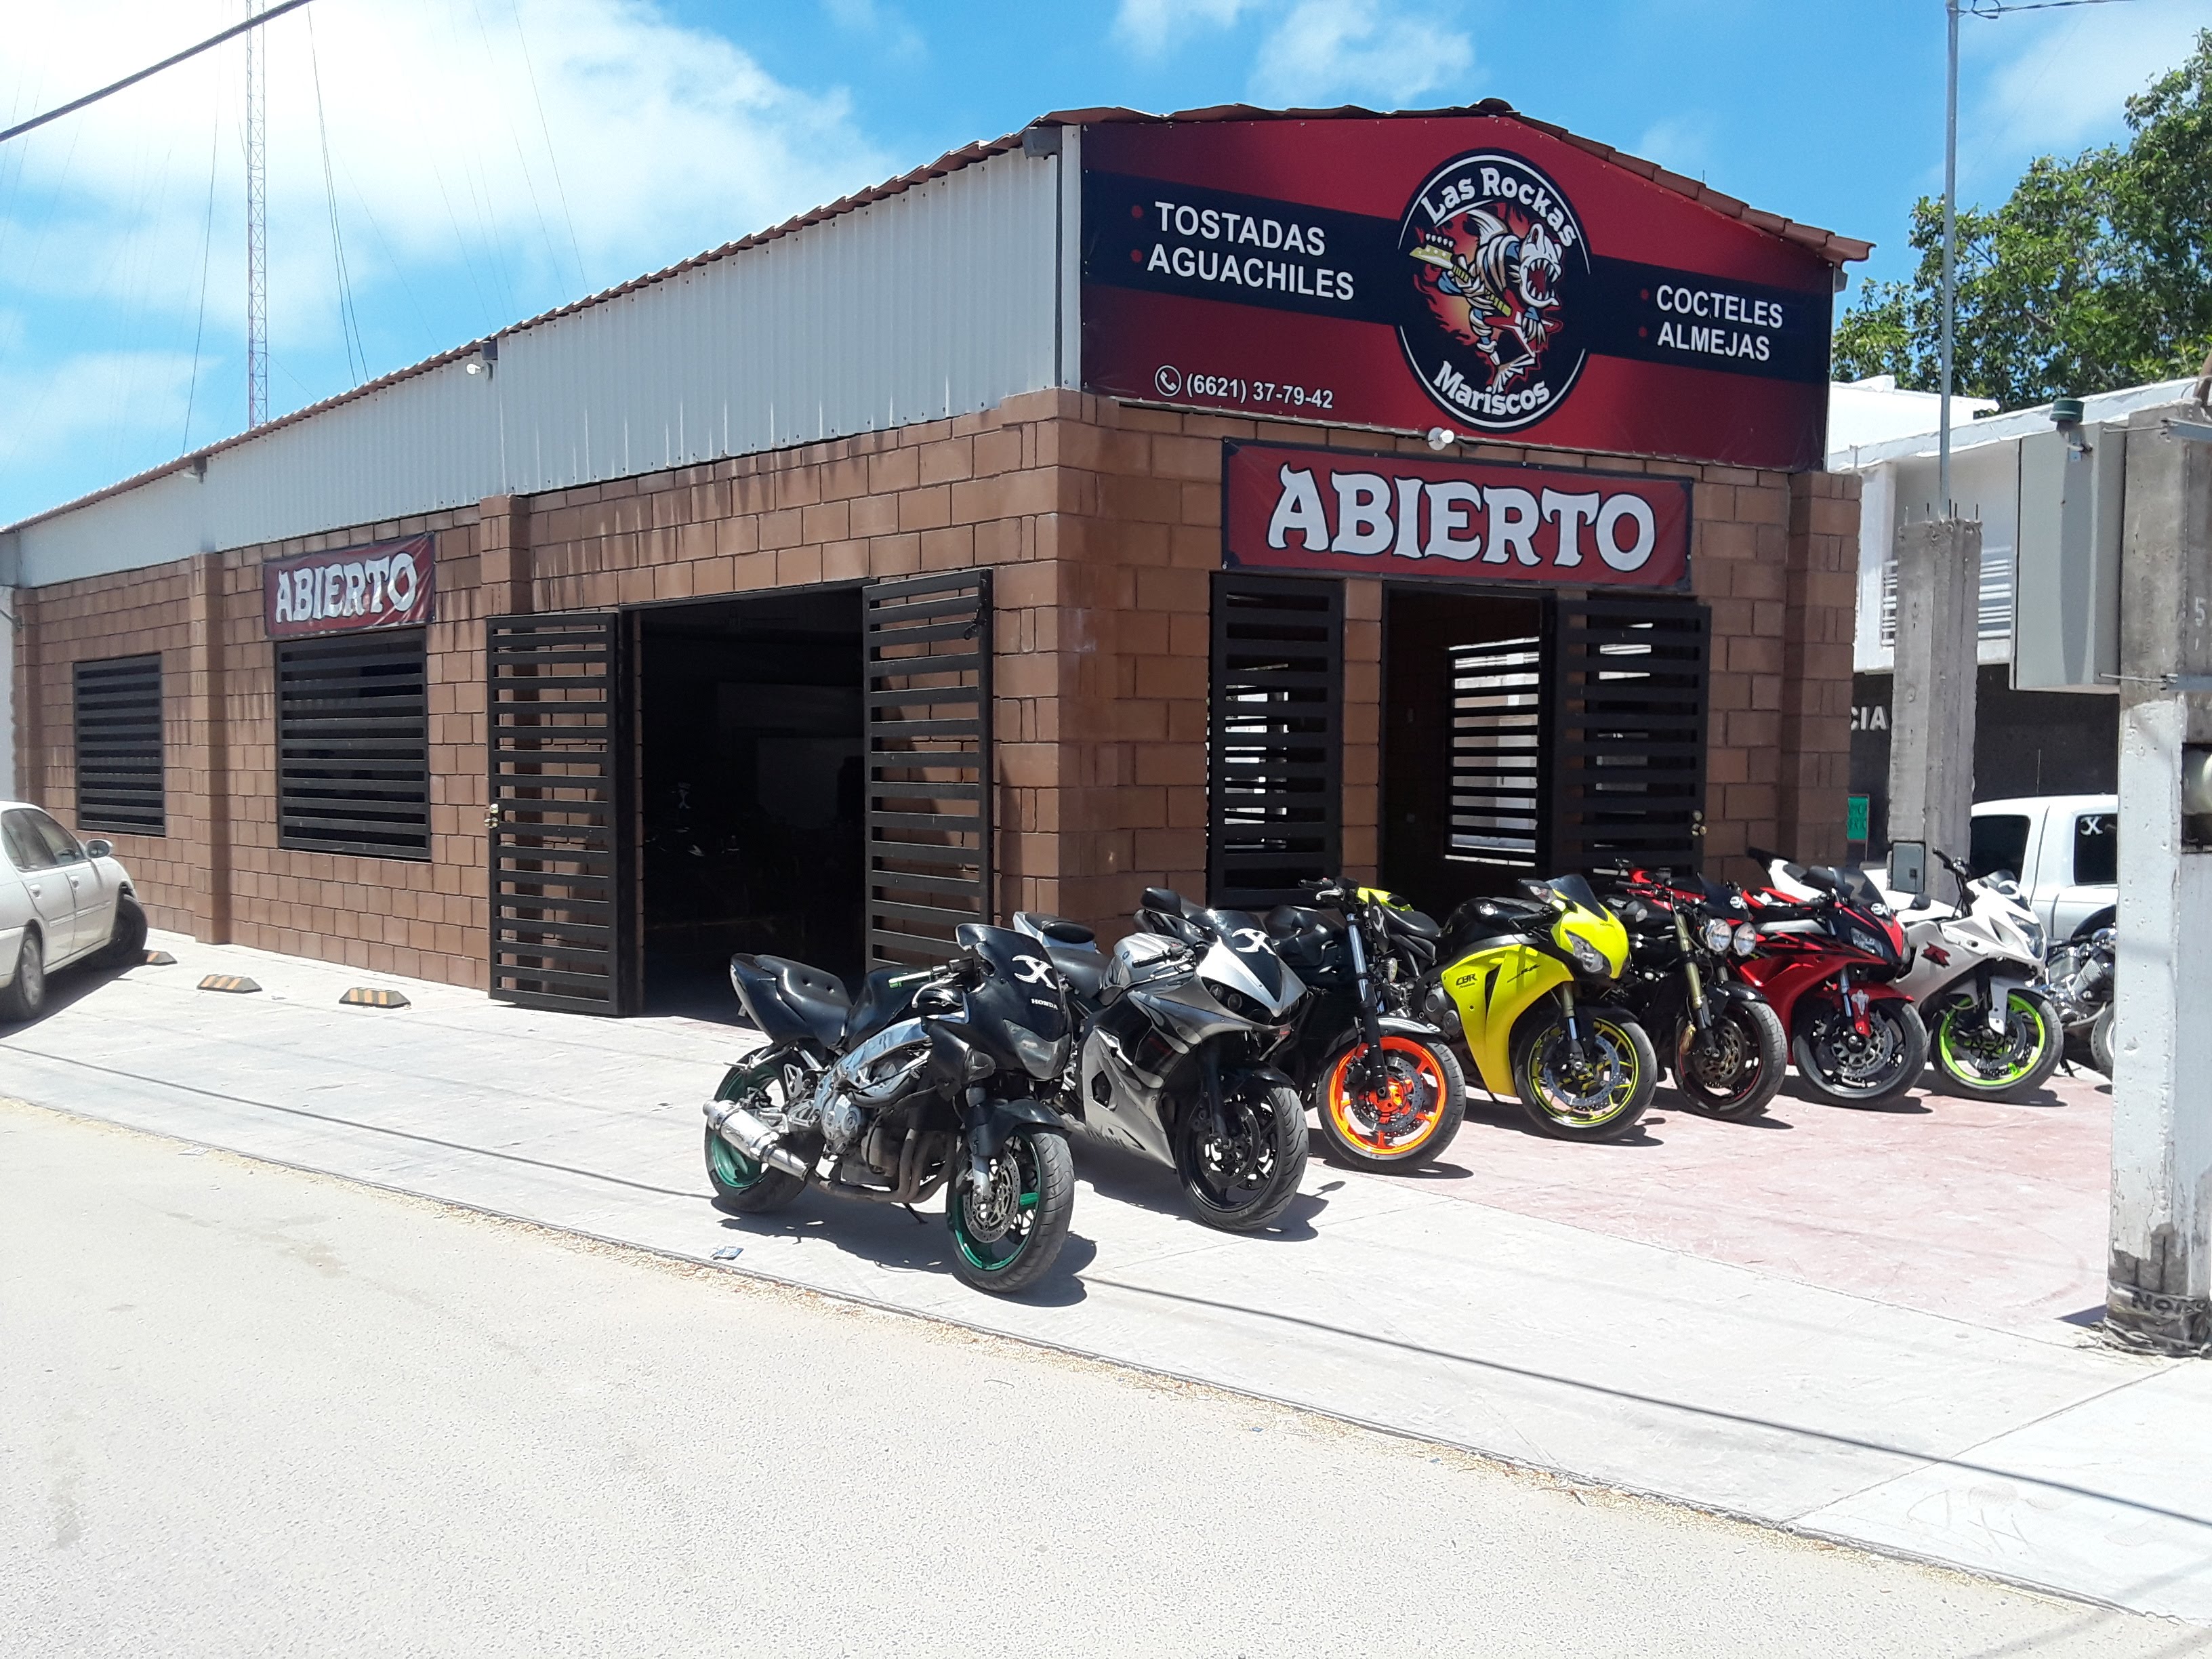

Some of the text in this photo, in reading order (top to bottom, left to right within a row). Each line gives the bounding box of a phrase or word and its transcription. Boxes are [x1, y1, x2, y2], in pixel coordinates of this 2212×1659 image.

[1154, 201, 1326, 256] TOSTADAS
[1421, 167, 1578, 247] Las Rockas
[1146, 243, 1354, 301] AGUACHILES
[1656, 284, 1783, 329] COCTELES
[1657, 321, 1770, 362] ALMEJAS
[1187, 373, 1334, 409] (6621) 37-79-42
[1433, 360, 1550, 416] Mariscos
[1267, 462, 1657, 573] ABIERTO
[275, 552, 417, 623] ABIERTO
[1031, 998, 1059, 1010] HONDA
